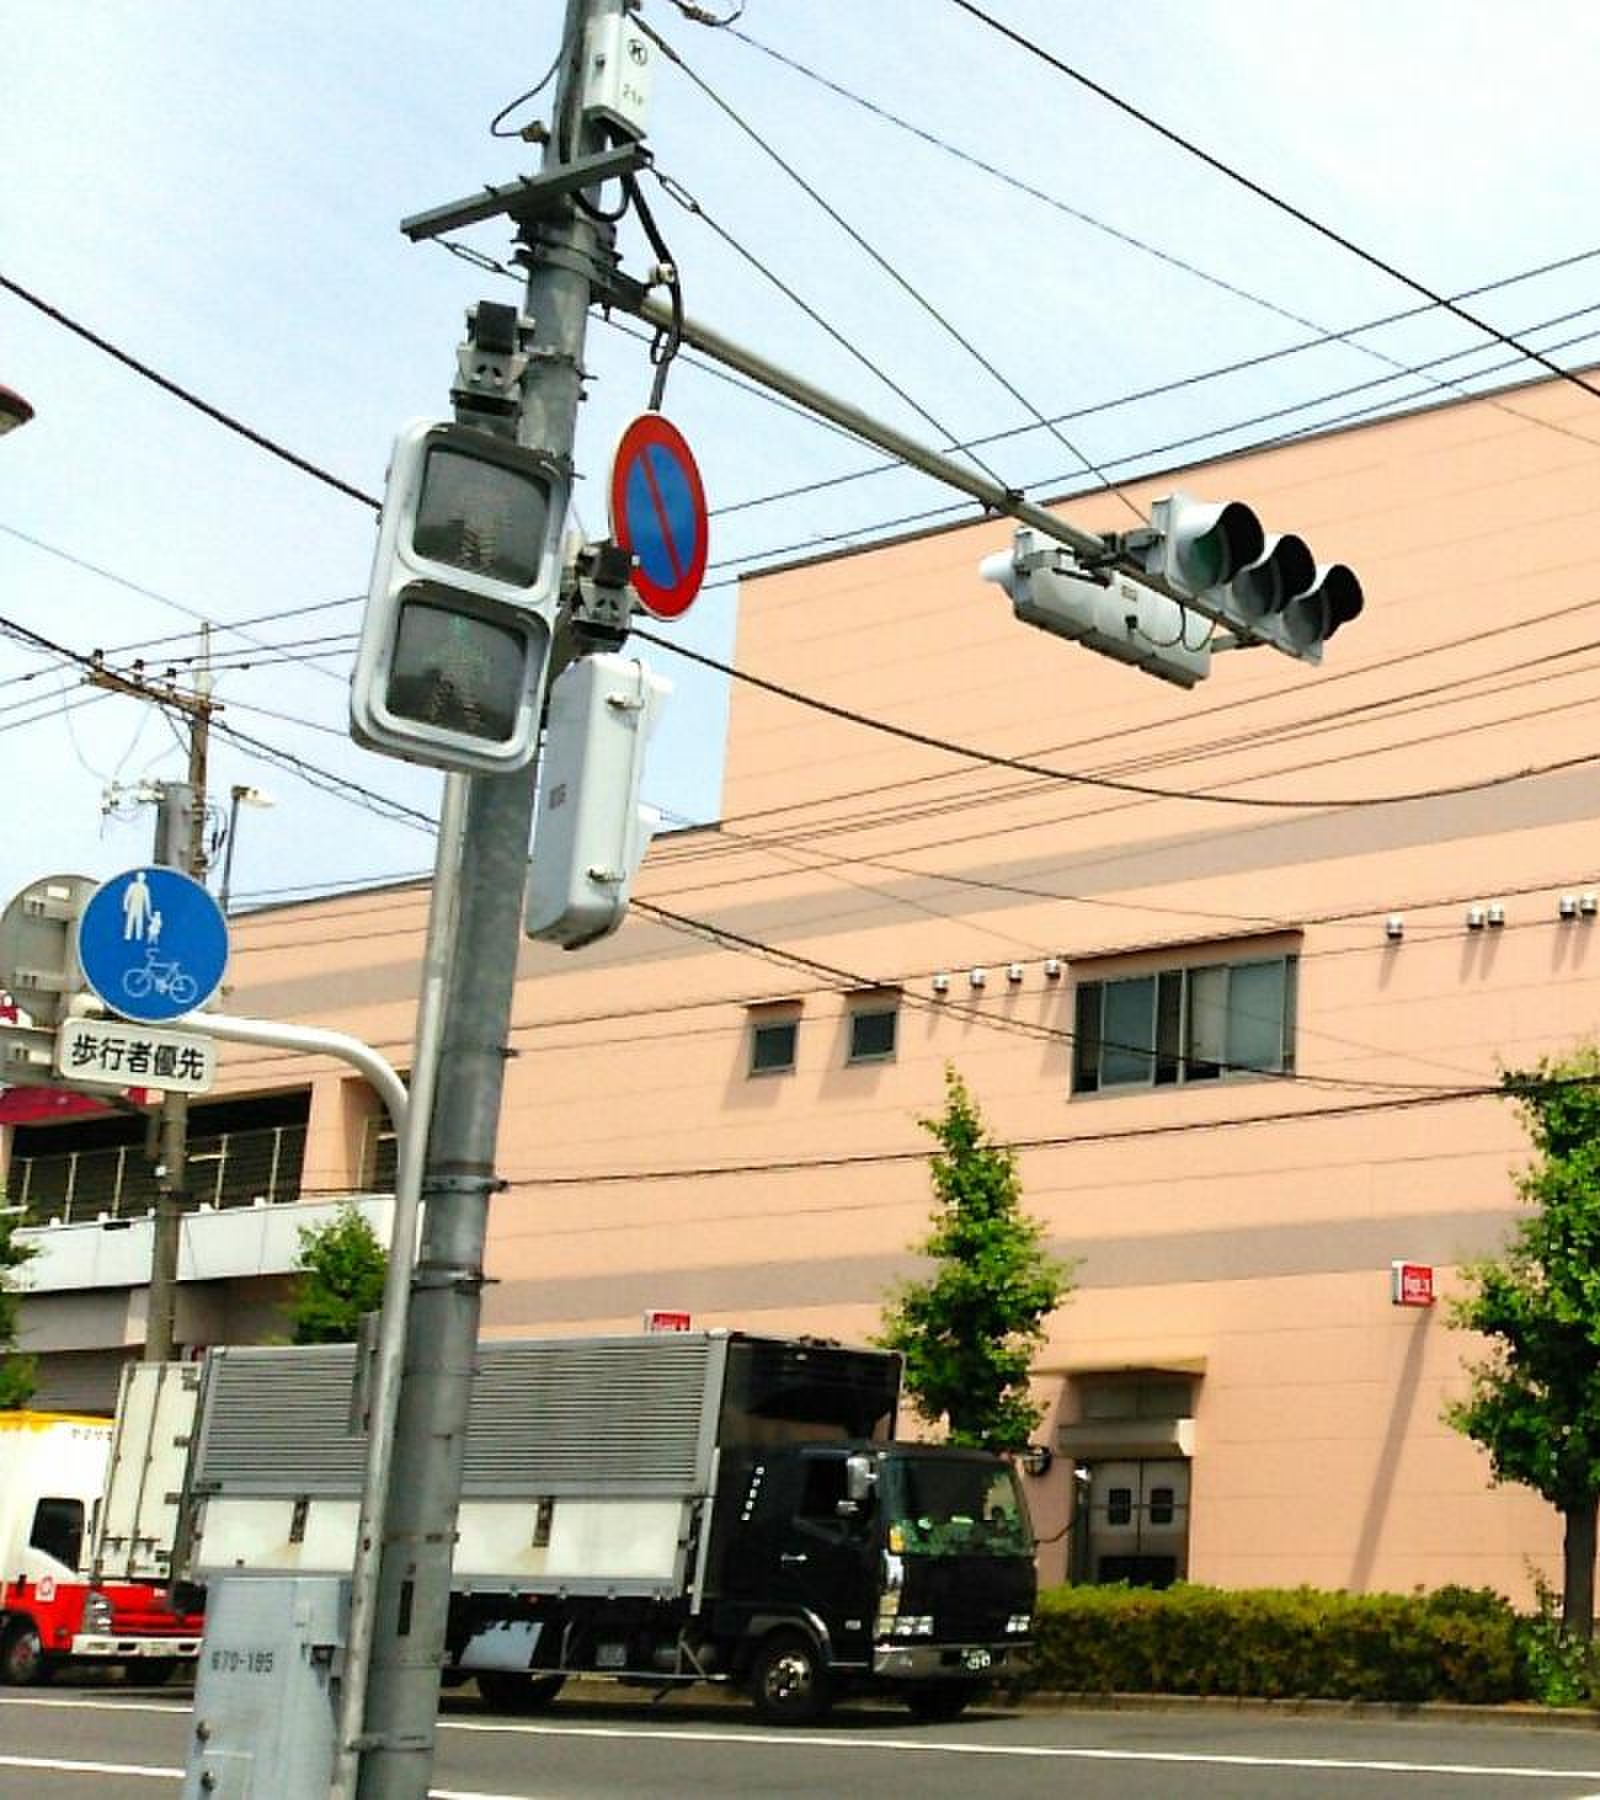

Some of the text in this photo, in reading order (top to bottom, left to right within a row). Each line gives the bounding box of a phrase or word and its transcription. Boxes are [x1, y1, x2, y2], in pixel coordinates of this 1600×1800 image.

[71, 1033, 204, 1080] 歩行者優先
